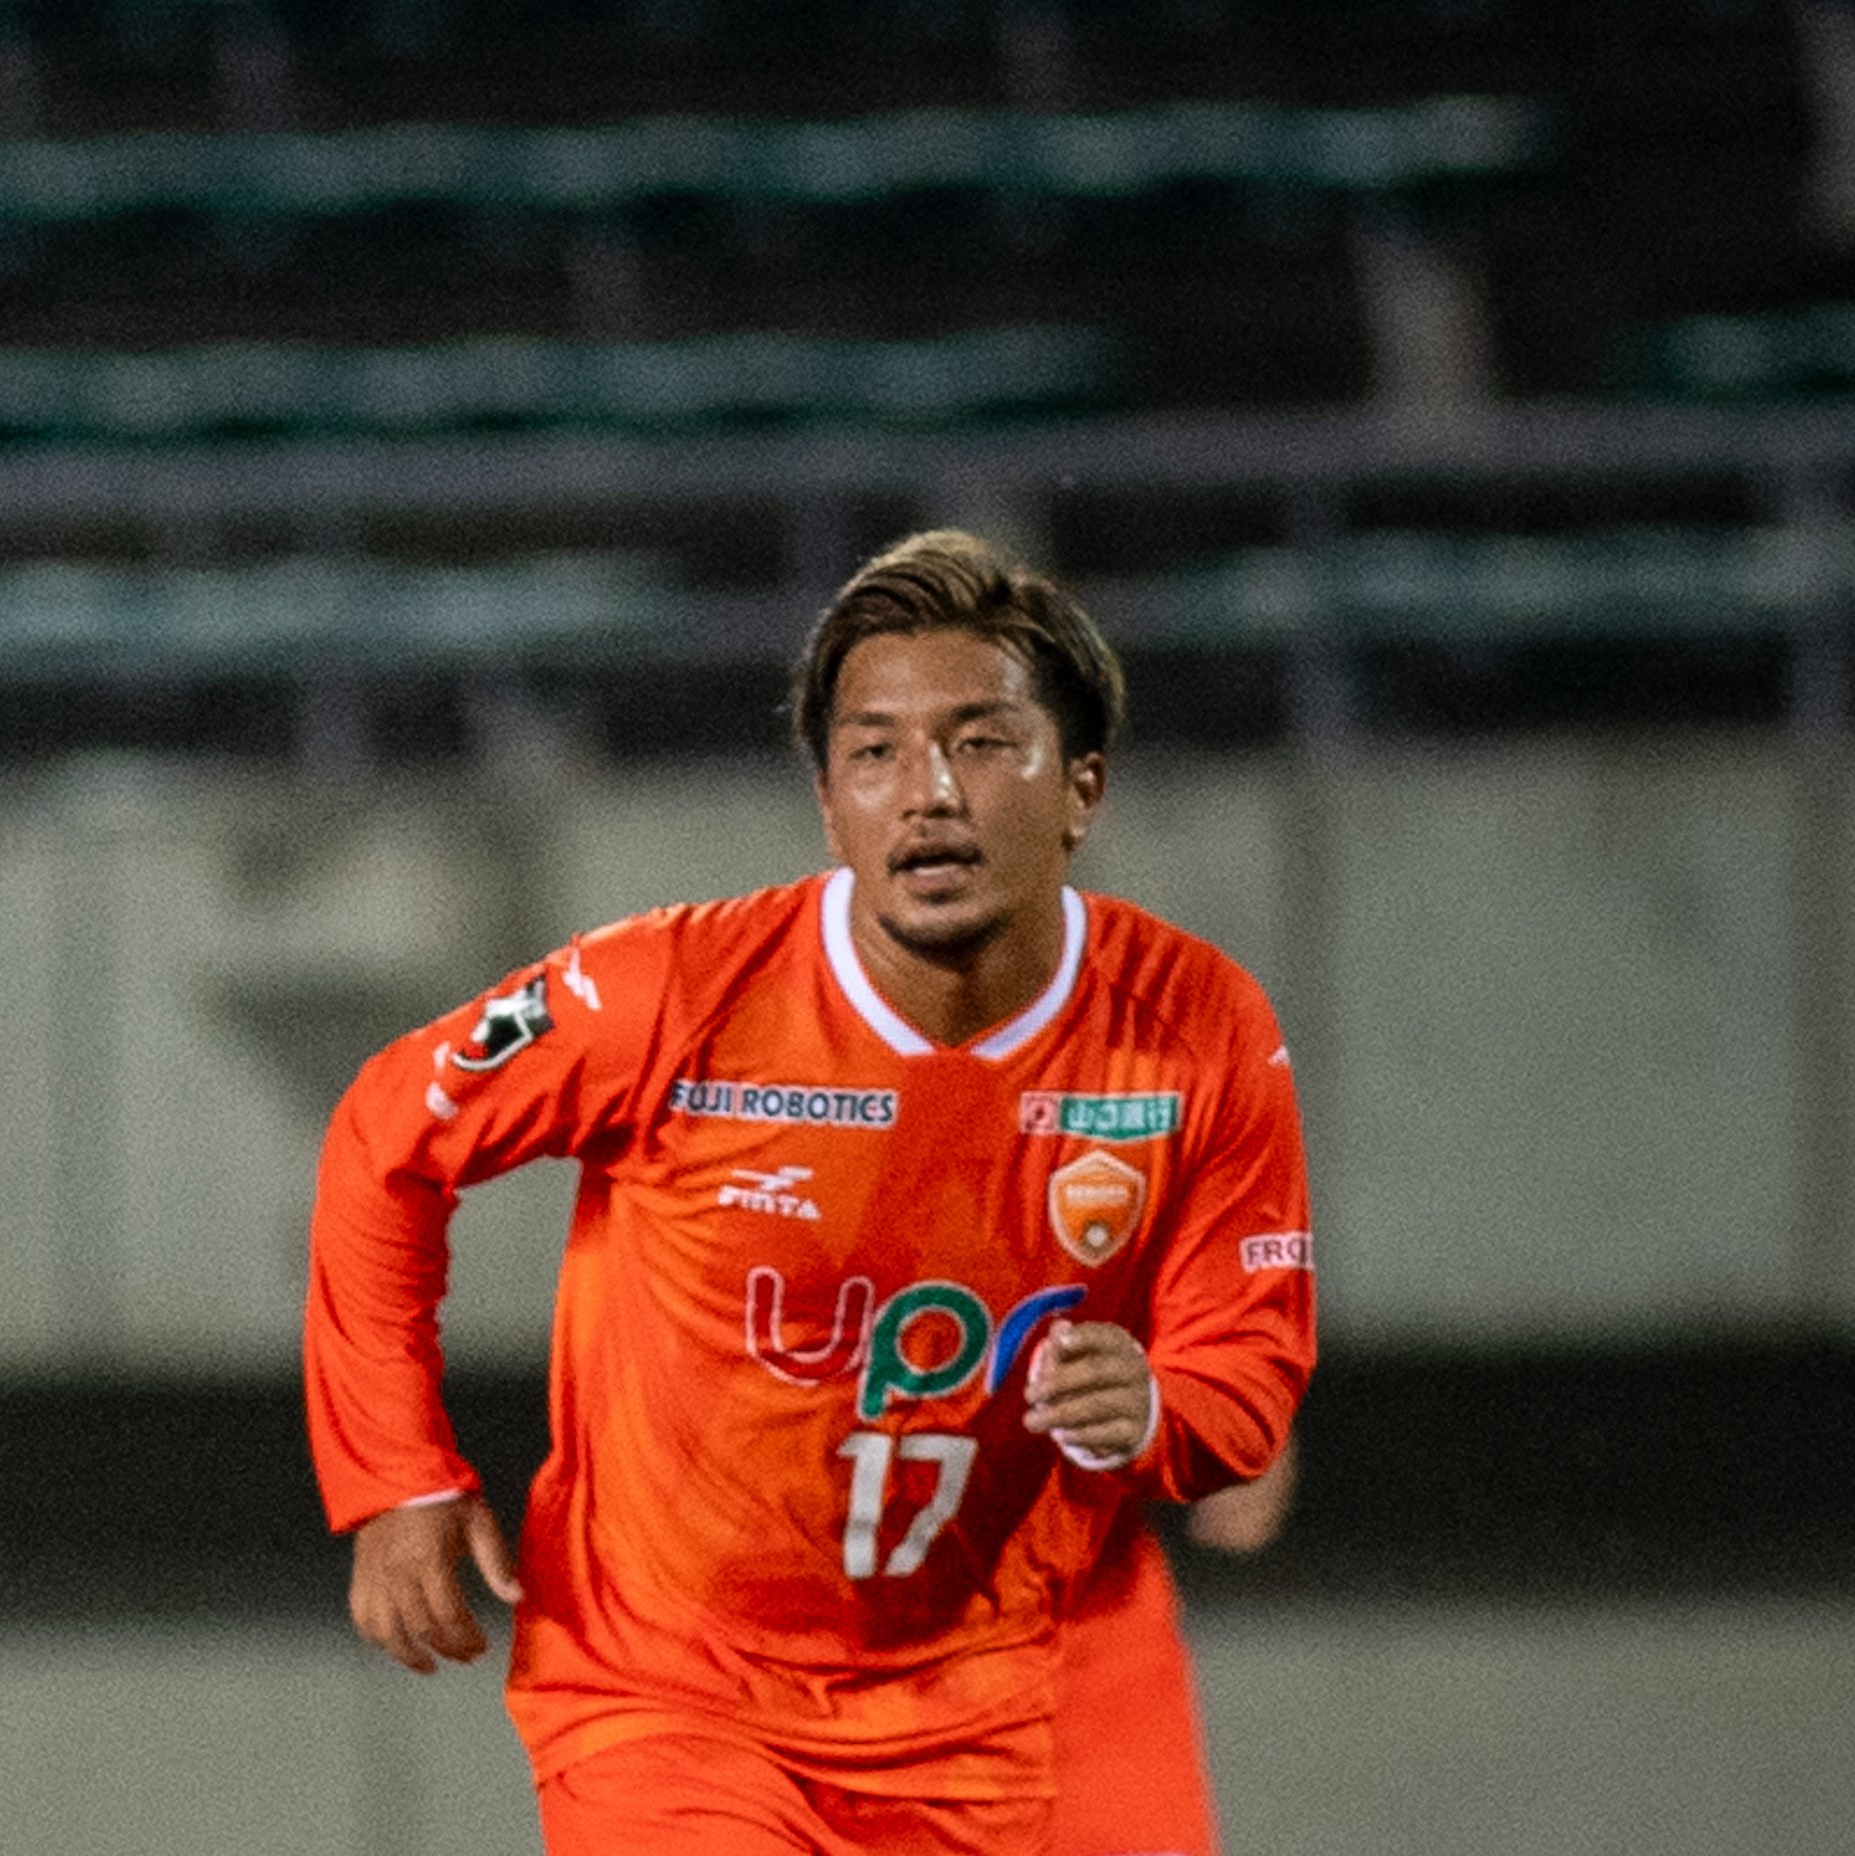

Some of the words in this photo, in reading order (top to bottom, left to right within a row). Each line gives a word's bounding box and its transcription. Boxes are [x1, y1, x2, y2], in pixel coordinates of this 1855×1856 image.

[672, 1081, 732, 1114] FUJI
[743, 1089, 894, 1122] ROBOTICS
[746, 1266, 1088, 1421] upr
[836, 1432, 979, 1579] 17
